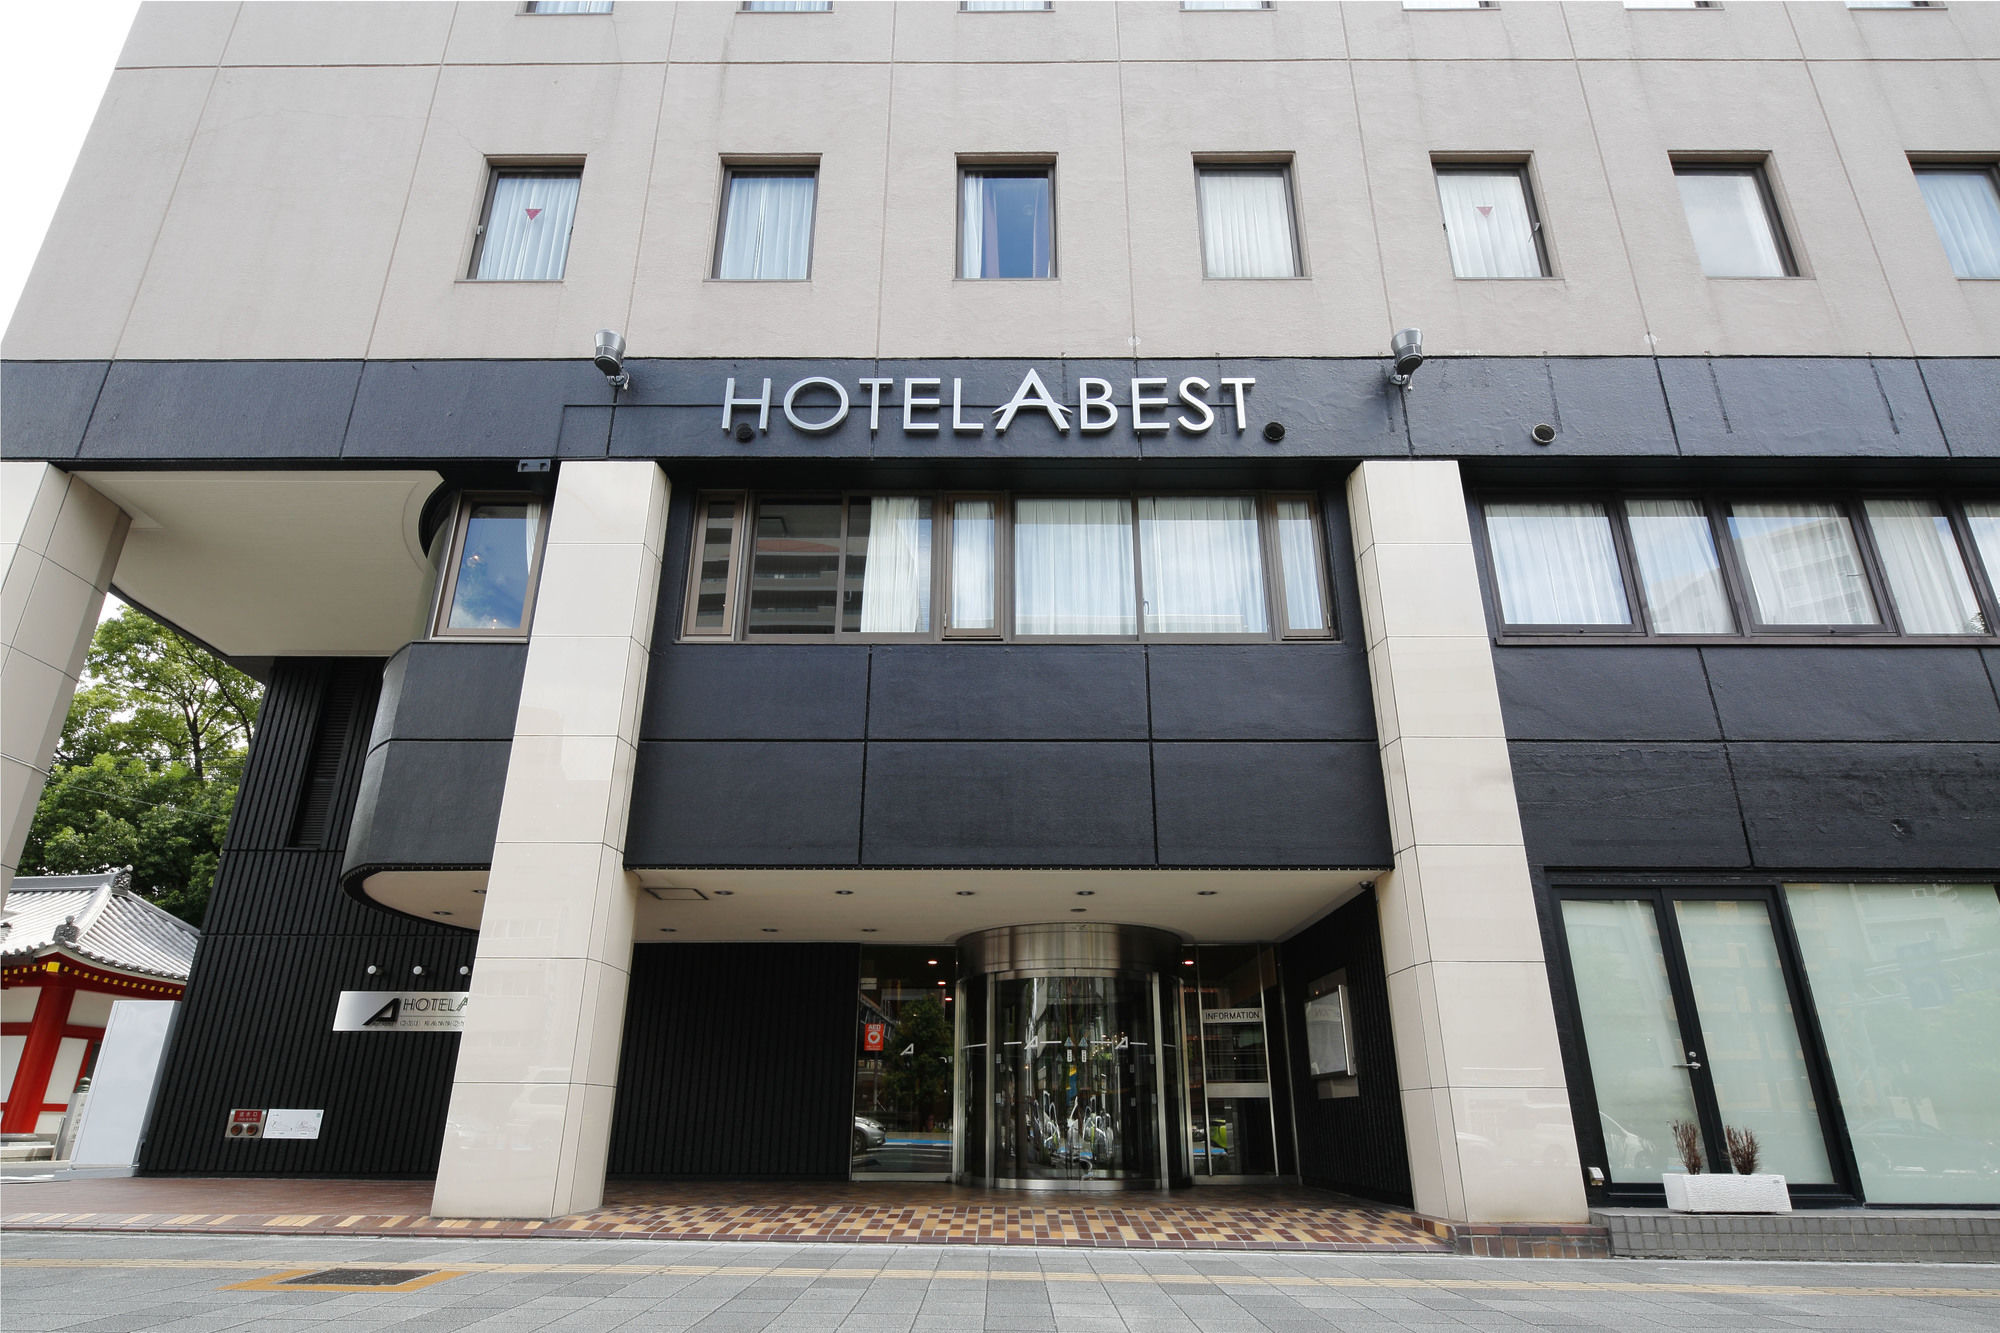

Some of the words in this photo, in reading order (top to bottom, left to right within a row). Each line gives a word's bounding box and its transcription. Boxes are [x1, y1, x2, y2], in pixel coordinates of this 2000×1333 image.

[721, 376, 984, 432] HOTEL
[992, 368, 1256, 432] ABEST
[1205, 1011, 1260, 1020] INFORMATION
